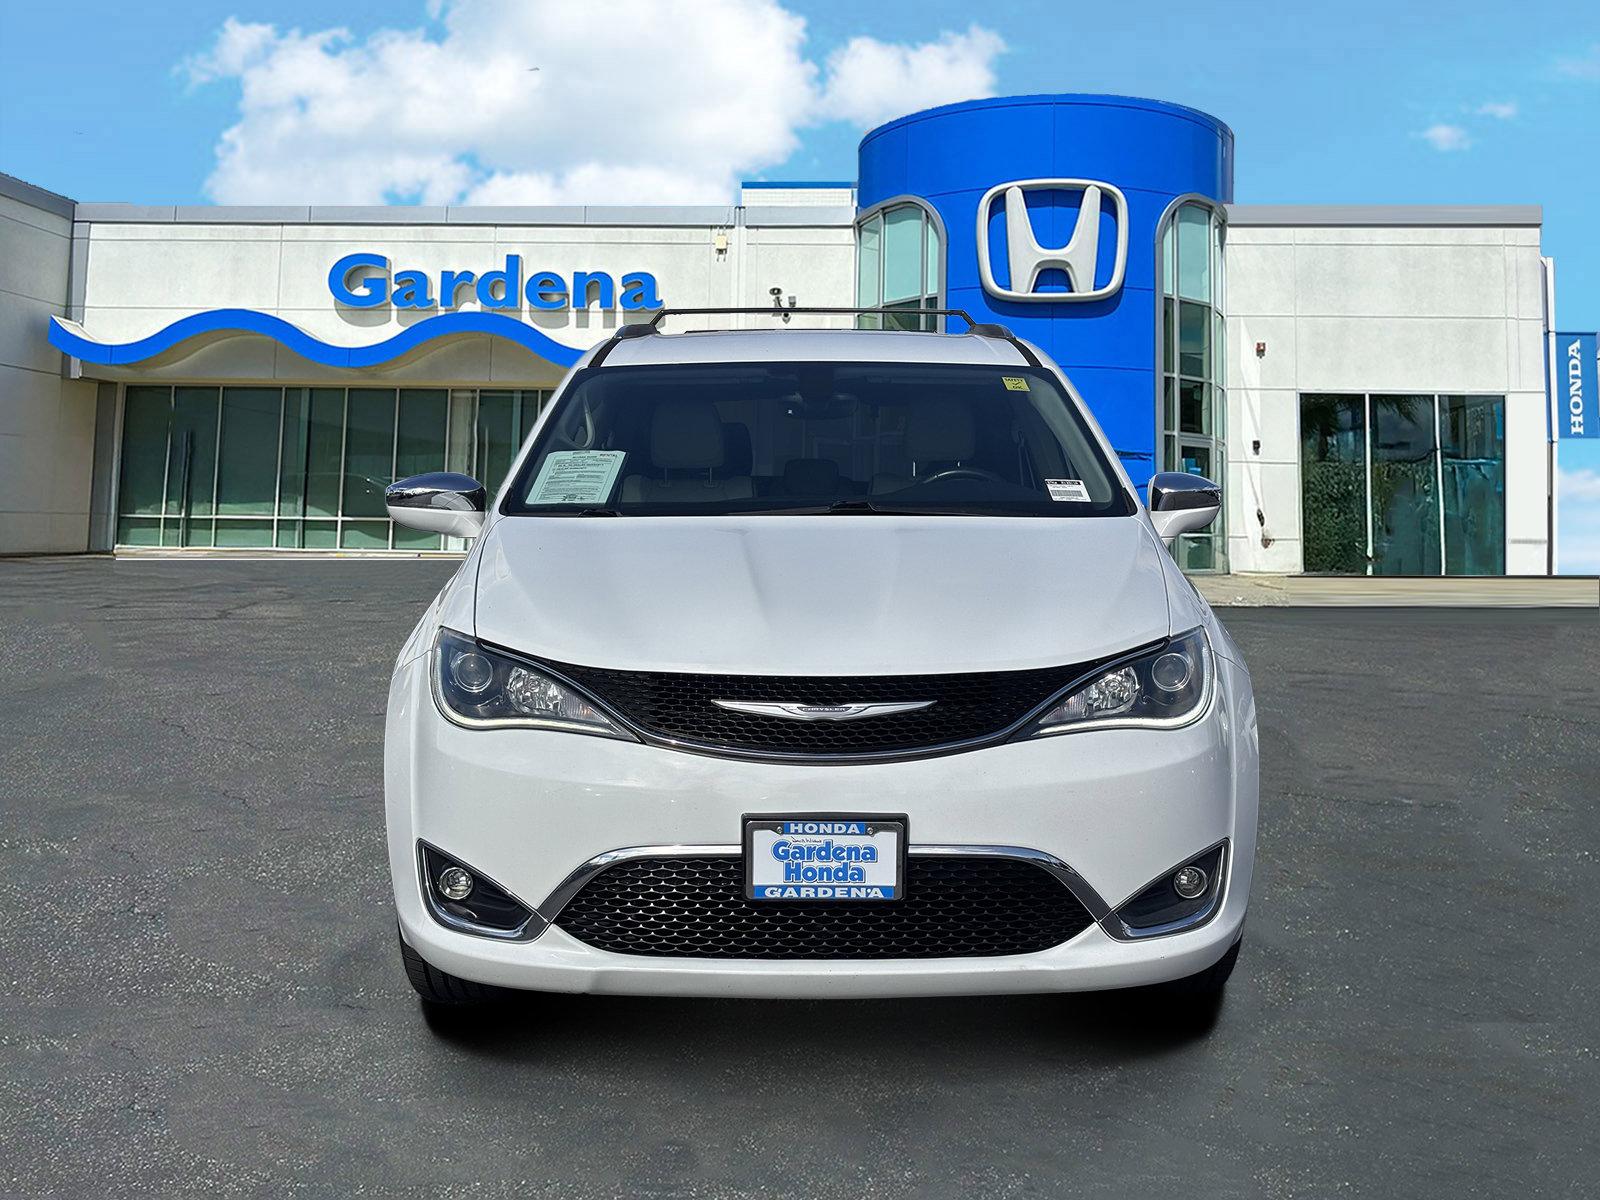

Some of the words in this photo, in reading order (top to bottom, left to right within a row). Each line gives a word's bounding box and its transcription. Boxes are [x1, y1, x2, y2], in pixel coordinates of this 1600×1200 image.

[328, 253, 664, 310] Gardena
[1568, 339, 1584, 435] HONDA
[790, 823, 861, 834] HONDA
[772, 840, 877, 862] Gardena
[783, 861, 866, 882] Honda
[765, 887, 884, 898] GARDENA
